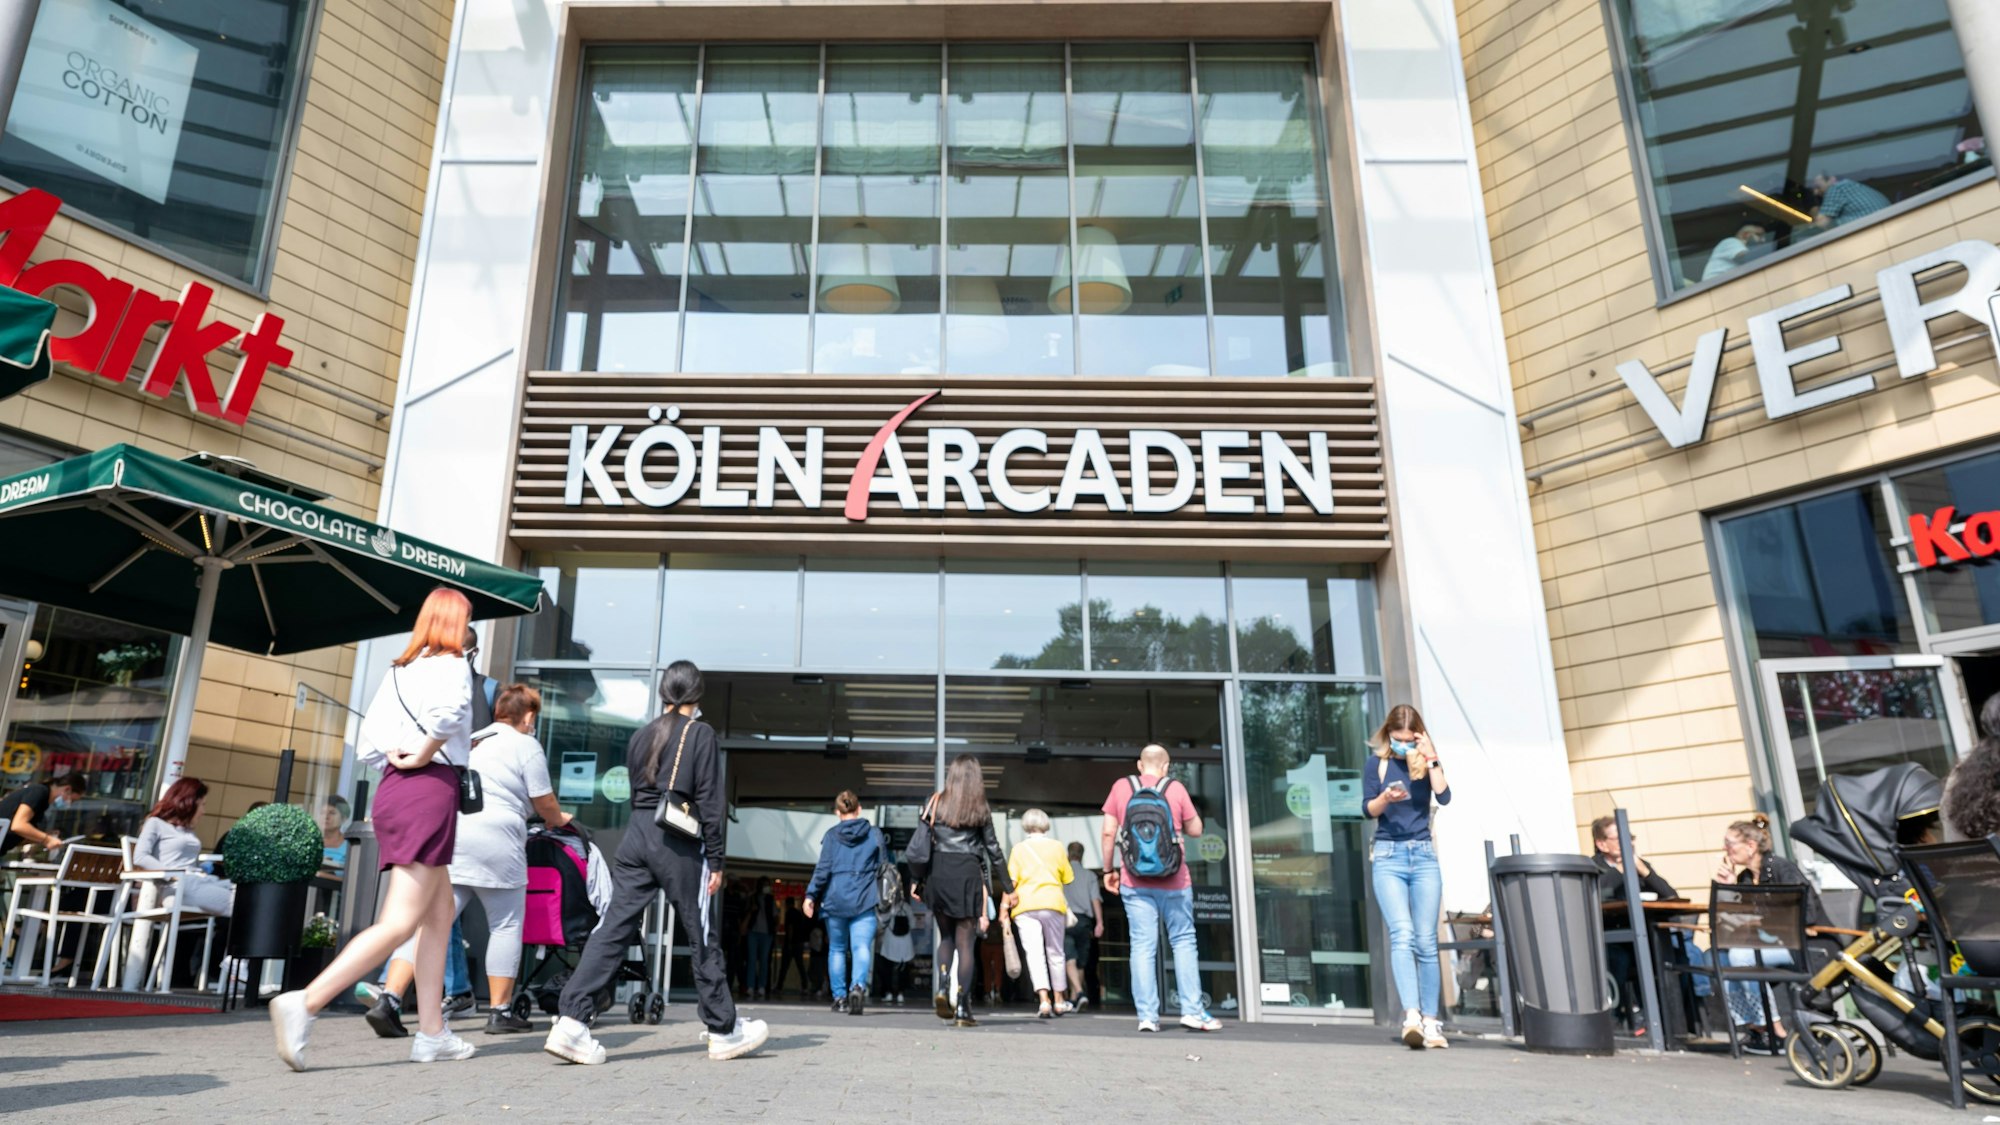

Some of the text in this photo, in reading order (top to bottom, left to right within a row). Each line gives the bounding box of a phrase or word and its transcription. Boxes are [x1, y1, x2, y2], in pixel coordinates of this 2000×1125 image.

[62, 70, 167, 135] COTTON
[67, 51, 169, 115] ORGANIC
[0, 472, 50, 504] DREAM
[564, 390, 1335, 521] KÖLN ARCADEN
[238, 491, 466, 578] CHOCOLATE DREAM
